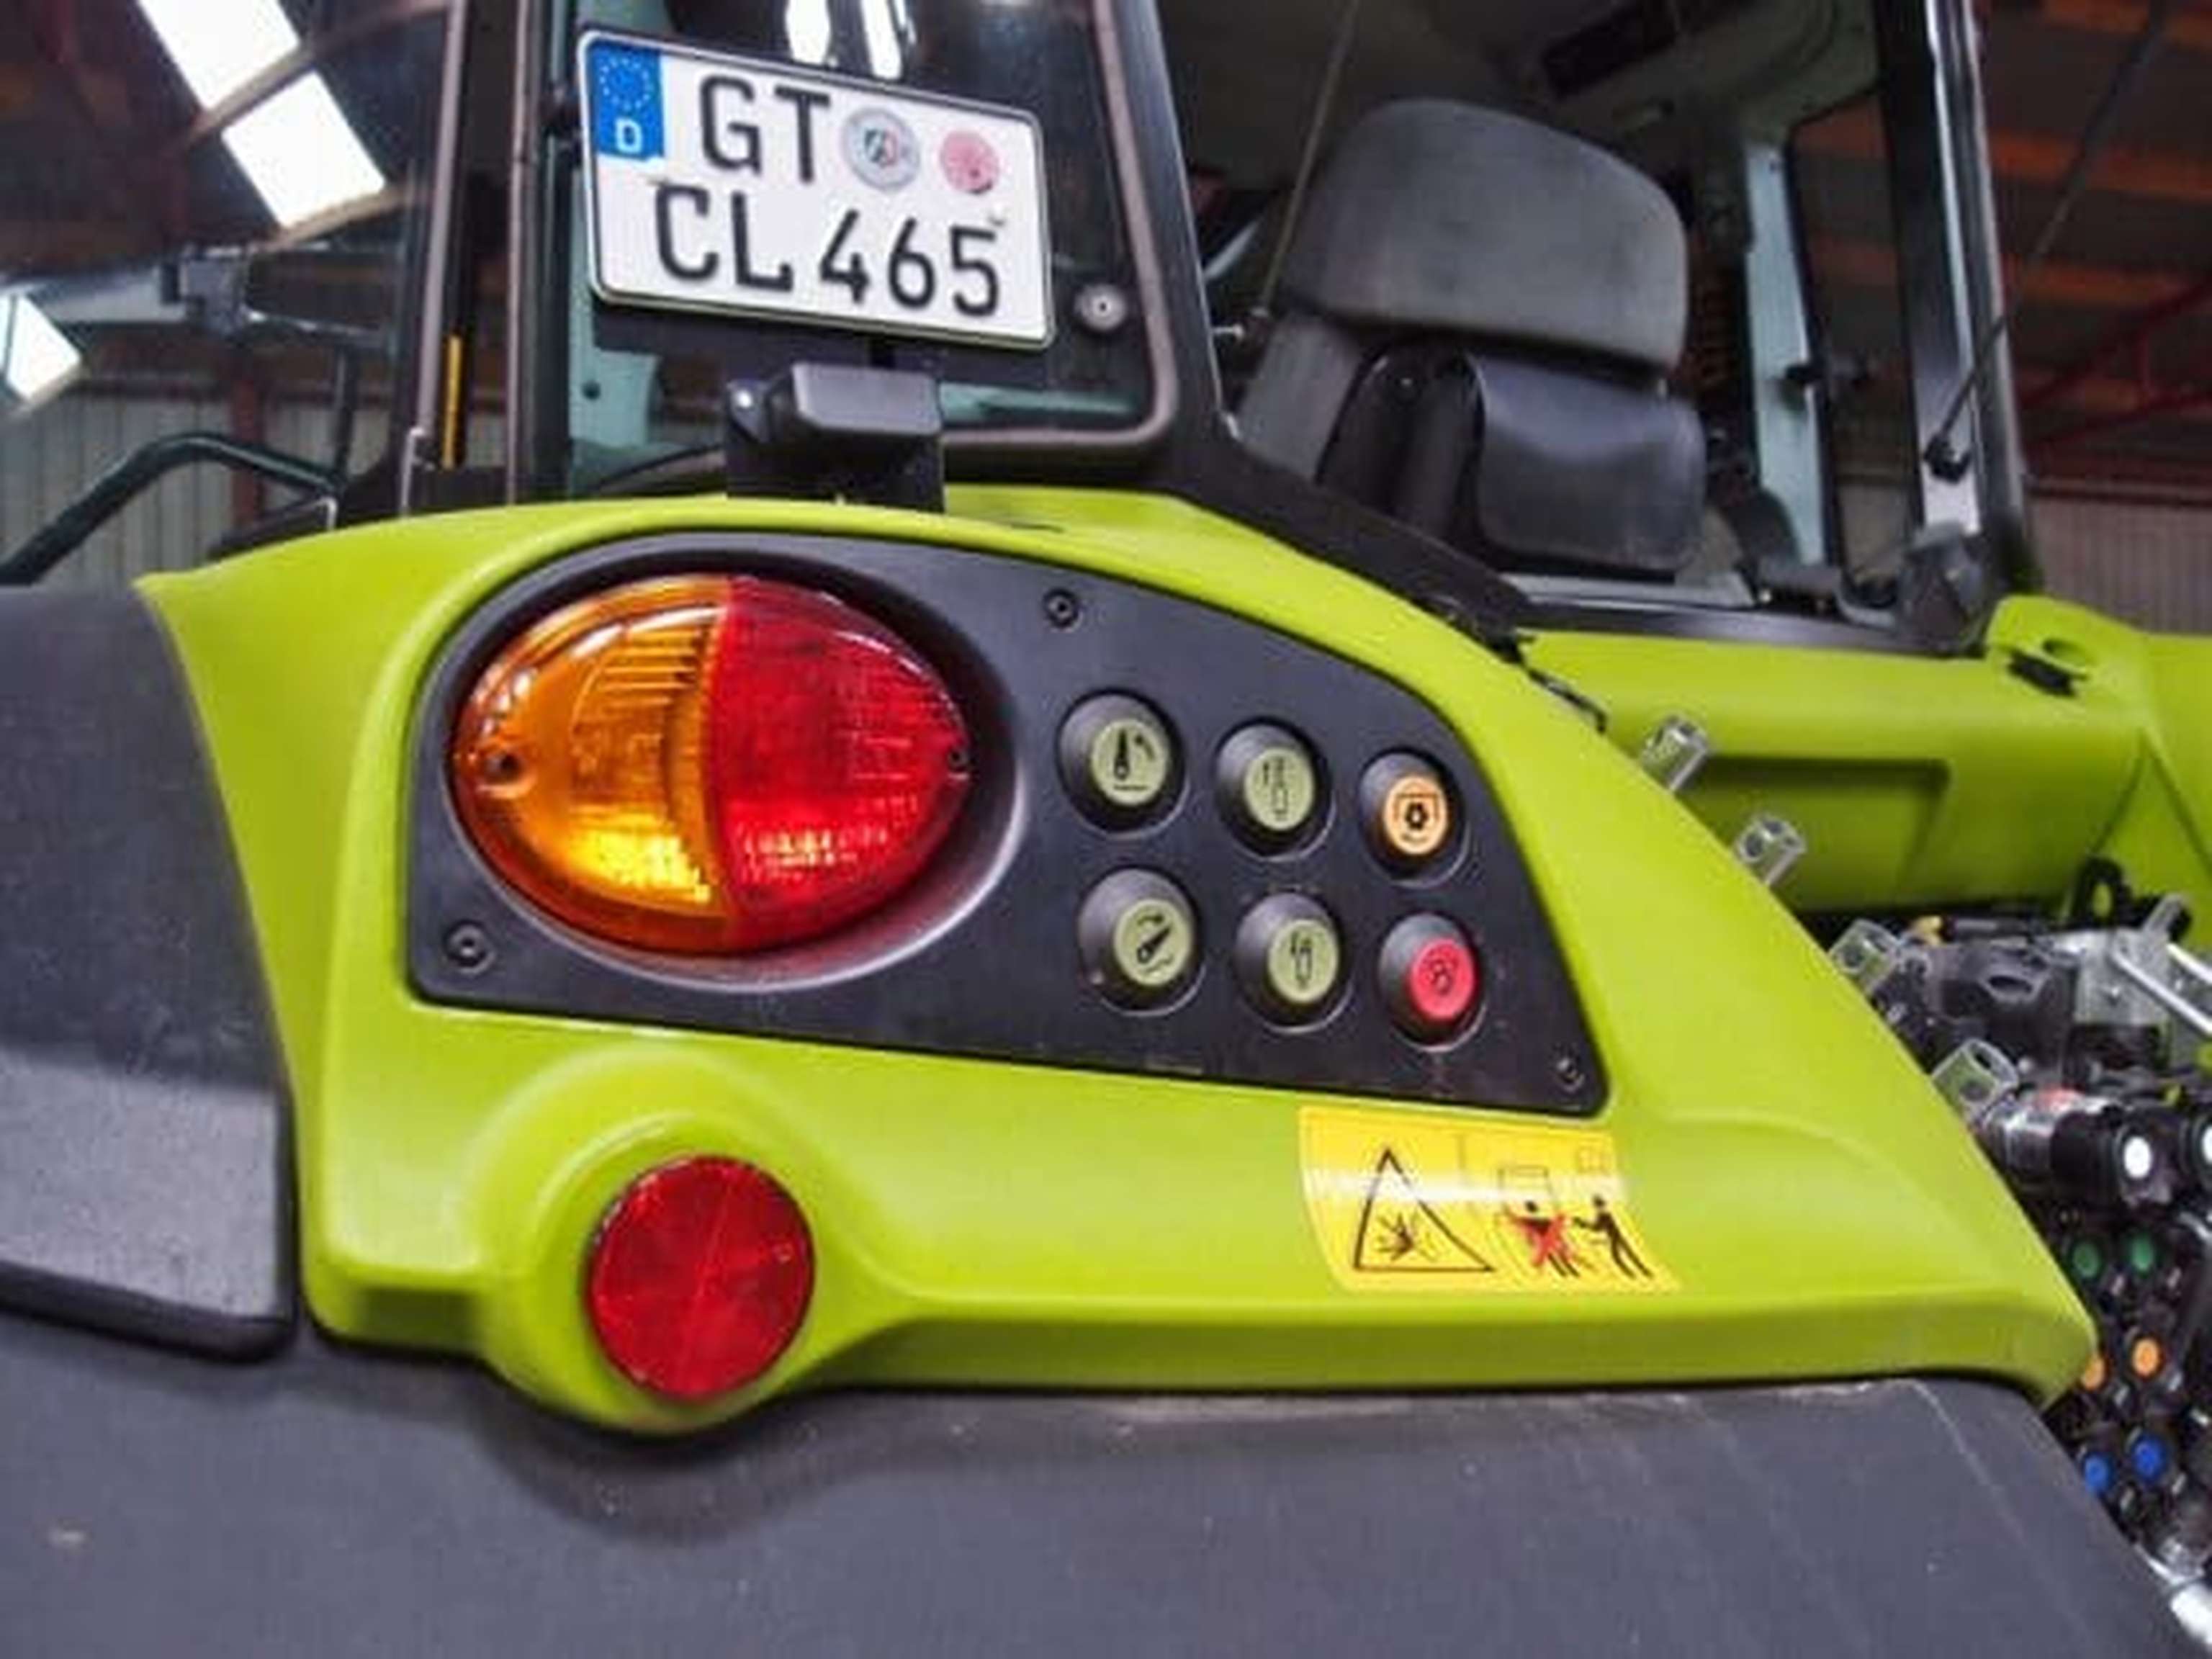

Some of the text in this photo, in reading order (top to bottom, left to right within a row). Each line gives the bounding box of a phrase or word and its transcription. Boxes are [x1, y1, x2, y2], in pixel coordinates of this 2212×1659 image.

[614, 118, 642, 152] D
[698, 74, 830, 183] GT
[655, 182, 1000, 318] CL 465
